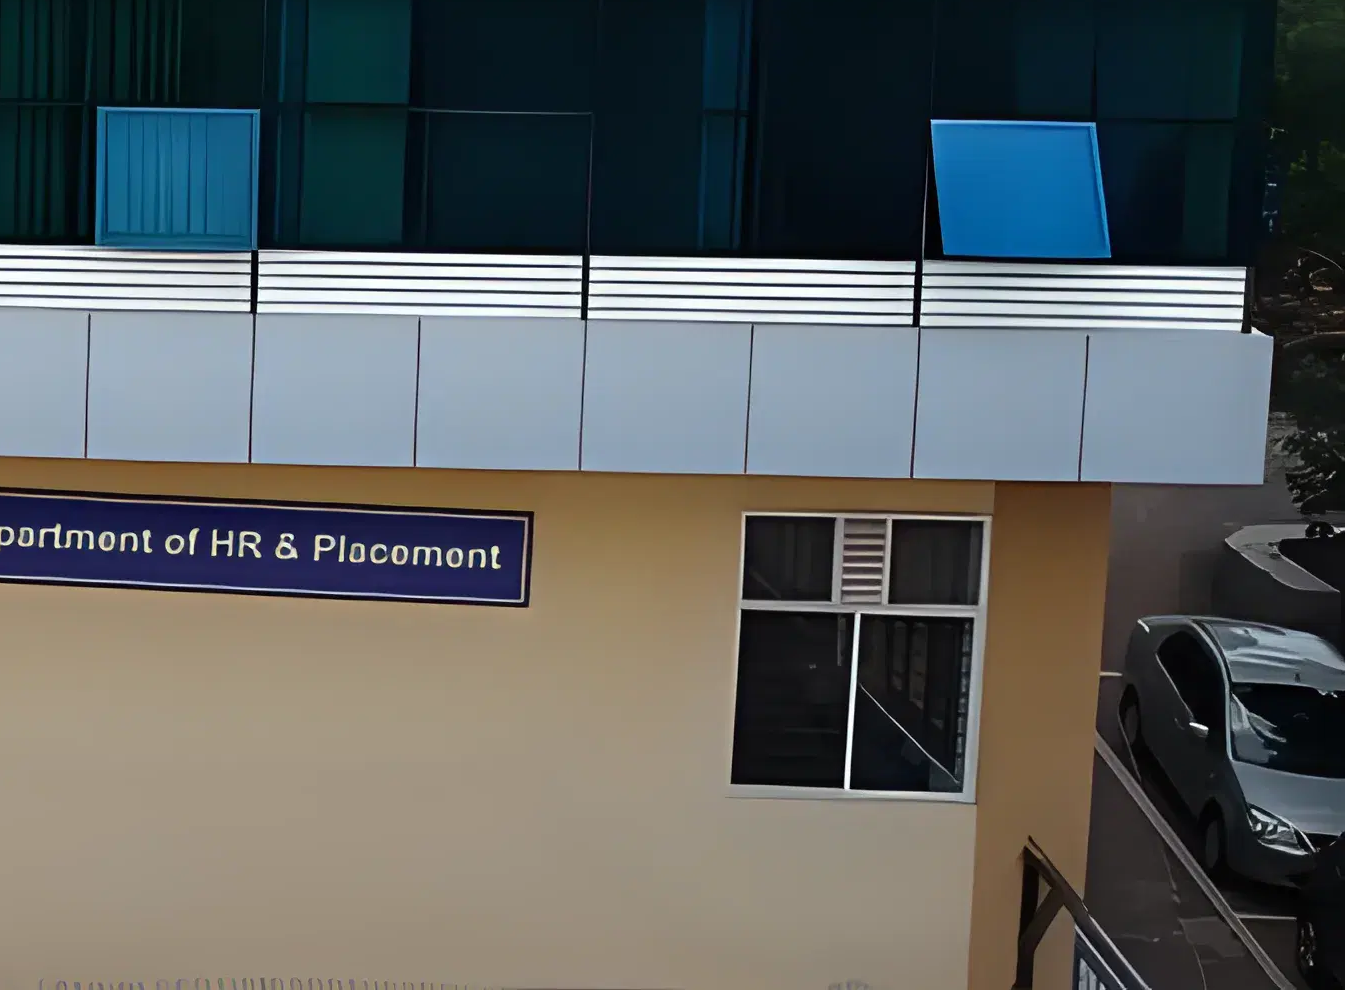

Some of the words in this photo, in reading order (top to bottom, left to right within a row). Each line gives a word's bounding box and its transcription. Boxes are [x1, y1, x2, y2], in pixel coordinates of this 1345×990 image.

[164, 527, 200, 556] of
[210, 528, 262, 559] HR
[274, 532, 299, 560] &
